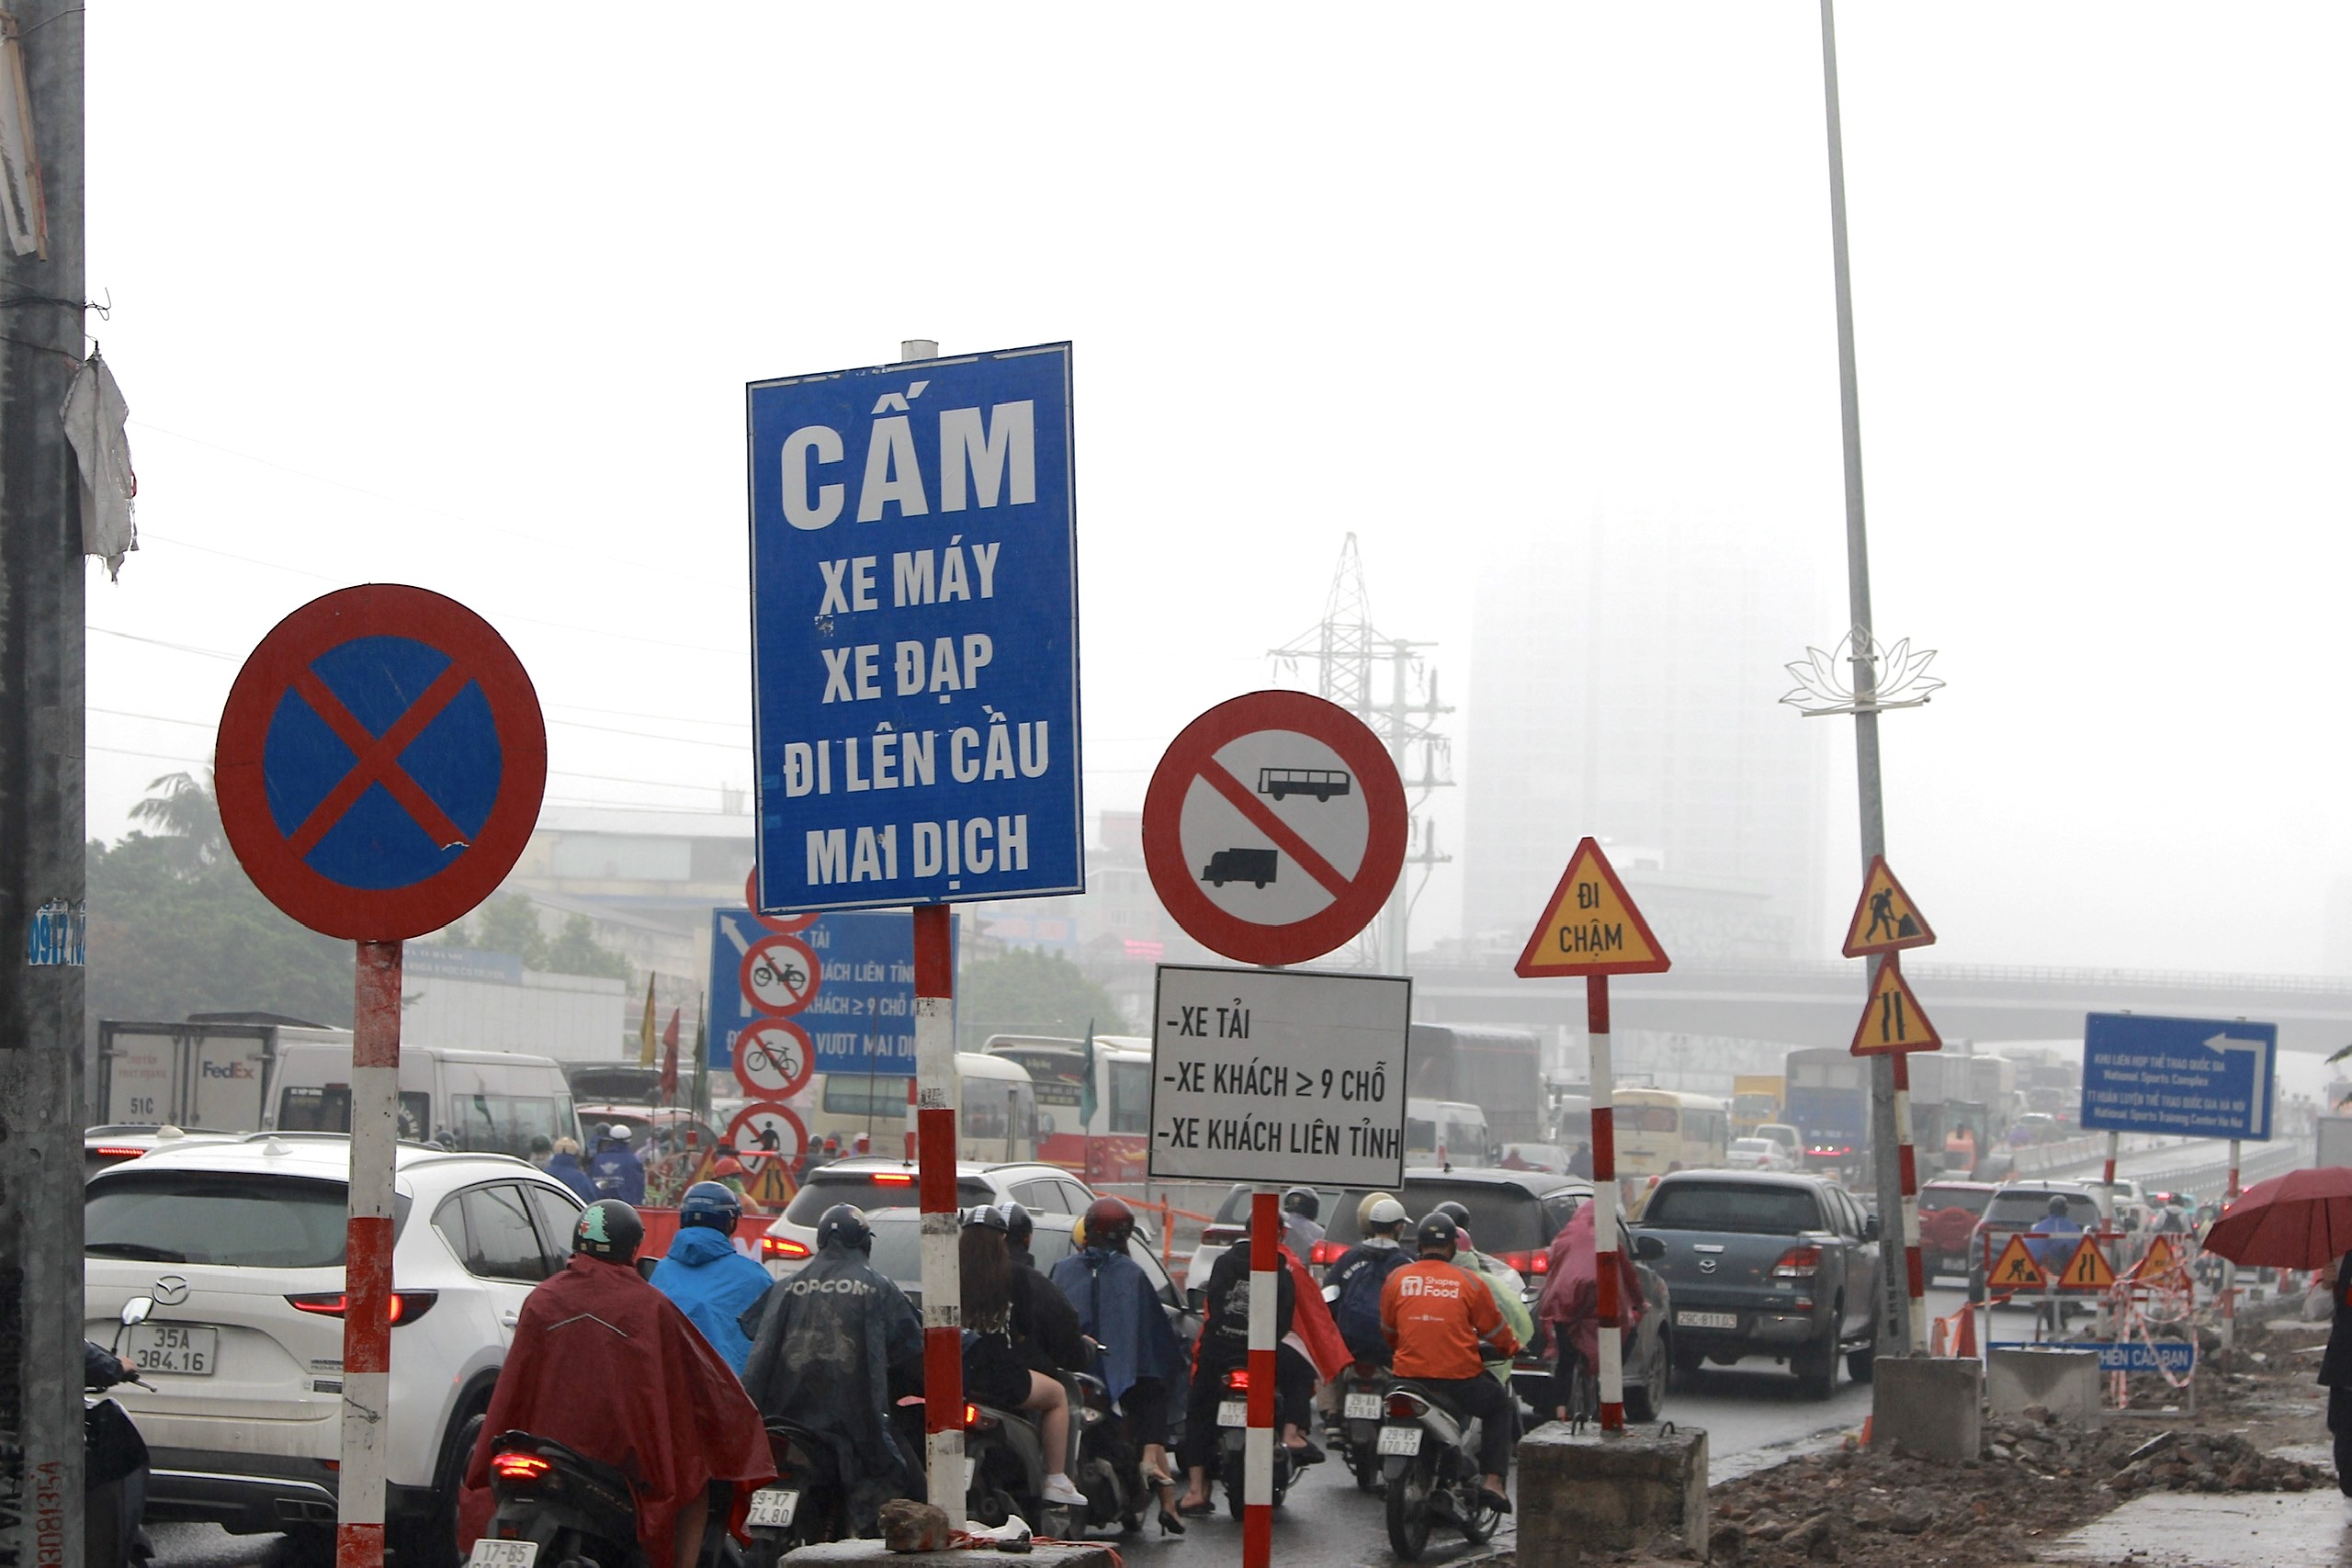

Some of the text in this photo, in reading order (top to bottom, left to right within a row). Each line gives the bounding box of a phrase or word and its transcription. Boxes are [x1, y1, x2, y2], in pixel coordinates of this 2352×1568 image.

[781, 381, 1035, 530] CẤM
[819, 535, 1001, 615] XE MÁY
[821, 634, 993, 704] XE ĐẠP
[783, 705, 1049, 798] ĐI LÊN CẦU
[807, 814, 1029, 890] MAI DỊCH
[1577, 882, 1599, 909] ĐI
[810, 923, 830, 948] TẢI
[1559, 919, 1623, 957] CHẬM
[854, 960, 884, 982] LIÊN
[867, 998, 876, 1015] 9
[880, 992, 906, 1016] CHỖ
[1216, 998, 1250, 1039] TẢI
[863, 1034, 892, 1057] MAI
[202, 1060, 254, 1079] FedEx
[1214, 1057, 1288, 1097] KHÁCH
[1321, 1068, 1333, 1099] 9
[1341, 1061, 1386, 1102] CHỖ
[130, 1098, 153, 1114] 51C
[1207, 1112, 1282, 1153] KHÁCH
[1290, 1118, 1340, 1155] LIÊN
[1349, 1117, 1400, 1159] TỈNH
[1424, 1285, 1459, 1299] Food
[1425, 1276, 1461, 1287] Shopee
[154, 1328, 189, 1350] 35A
[137, 1349, 204, 1371] 384.16
[36, 1461, 63, 1568] 308135A
